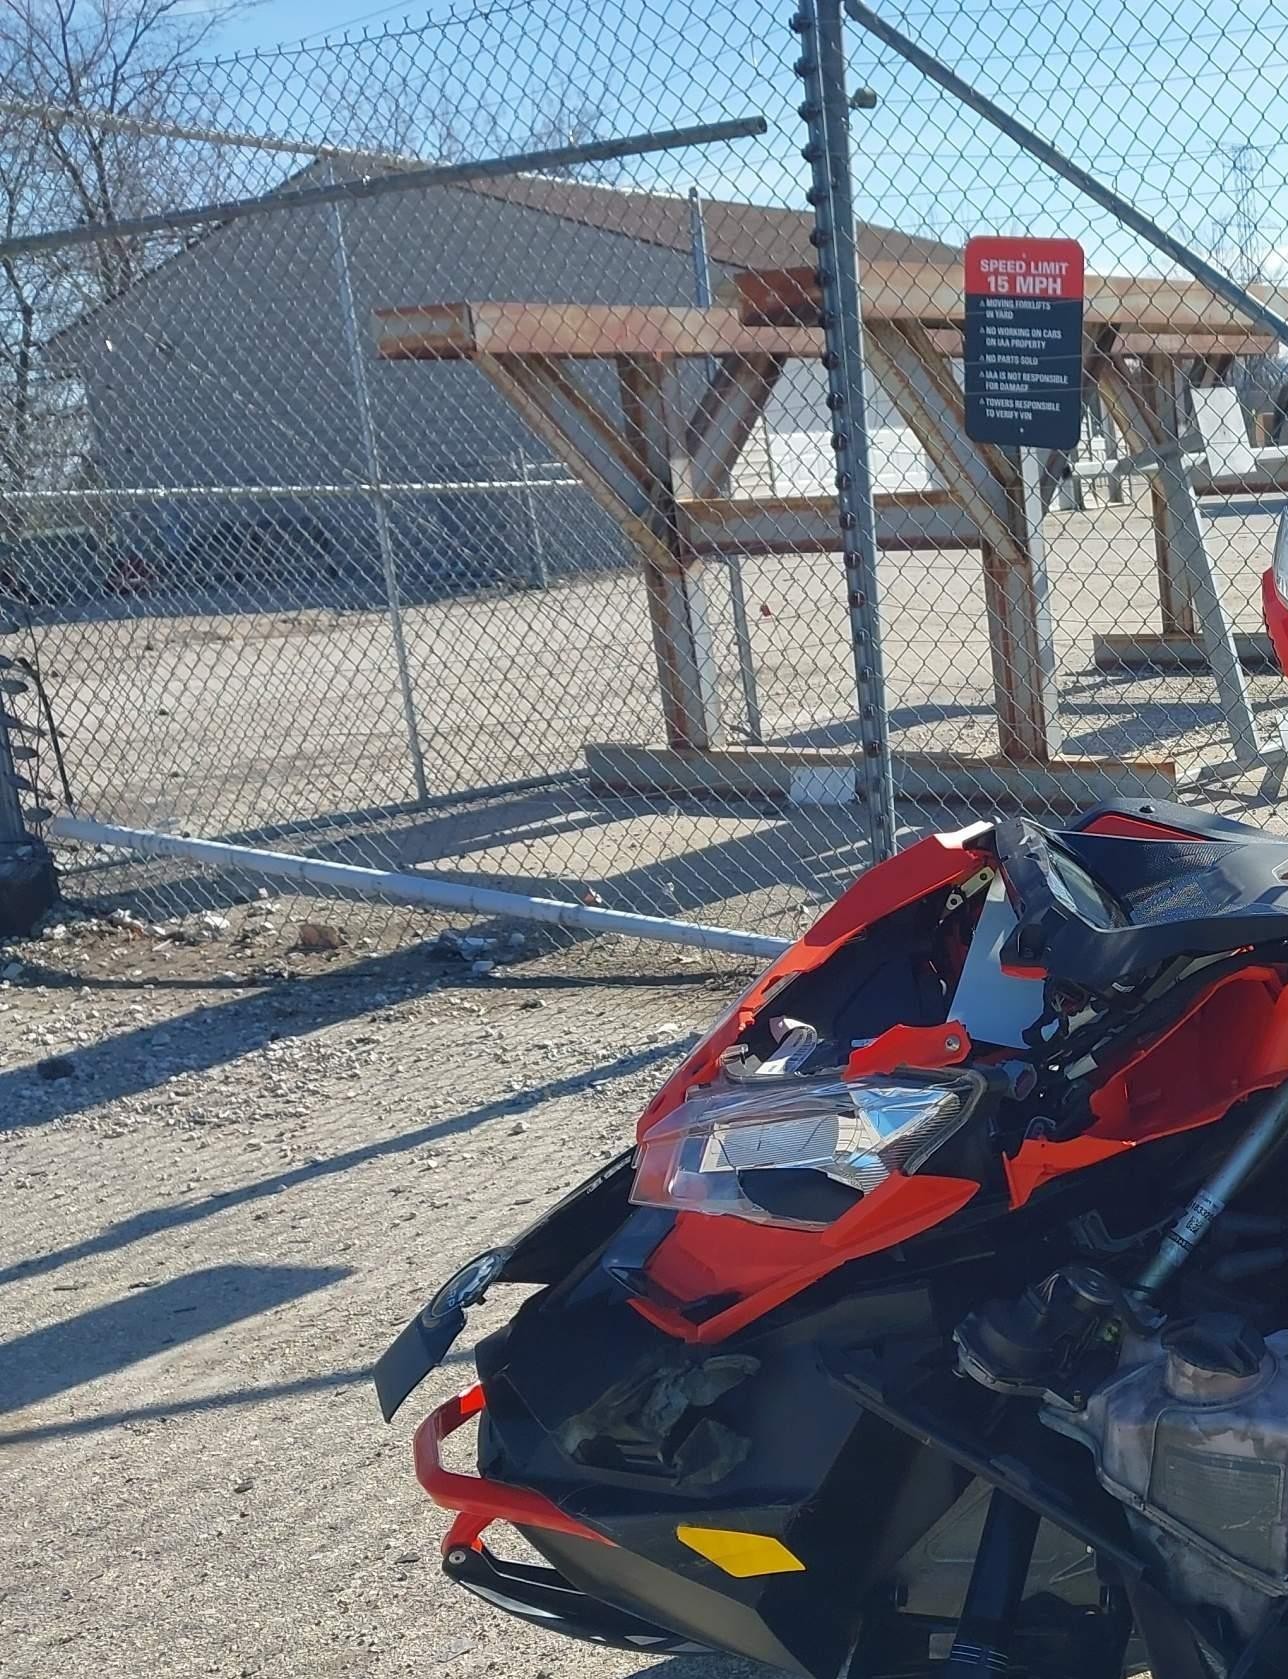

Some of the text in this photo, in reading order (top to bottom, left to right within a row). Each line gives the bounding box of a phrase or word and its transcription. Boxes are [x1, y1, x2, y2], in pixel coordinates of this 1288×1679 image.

[980, 259, 1069, 275] SPEED LIMIT
[987, 275, 1062, 295] 15 MPH
[986, 298, 1051, 310] MOVING FORKLIFTS
[985, 310, 1014, 320] IN YARD
[986, 326, 1062, 339] NO WORKING ON CARS
[986, 337, 1046, 349] ON IAA PROPERTY
[986, 353, 1039, 366] NO PARTS SOLD
[985, 370, 1068, 384] IAA IS NOT RESPONSIBLE
[985, 381, 1029, 392] FOR DAMAGE
[986, 398, 1060, 411] TOWERS RESPONSIBLE
[986, 409, 1033, 421] TO VERIFY VIN
